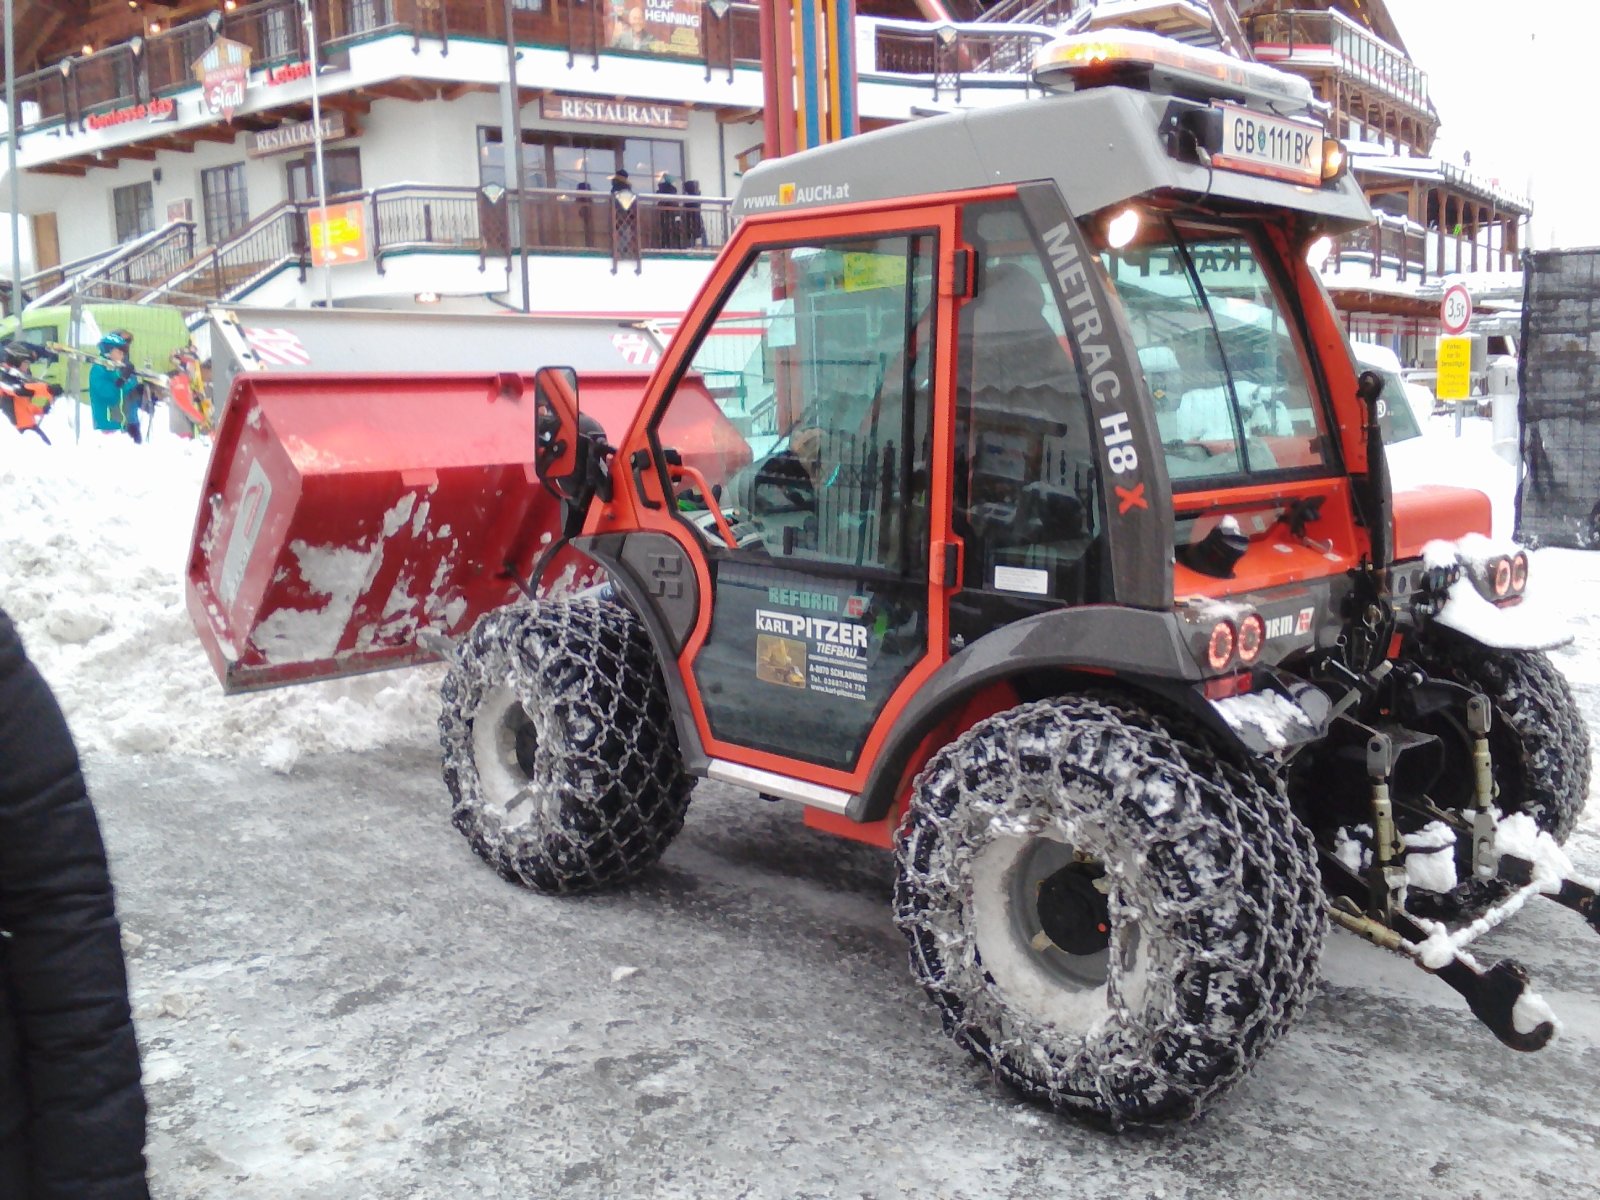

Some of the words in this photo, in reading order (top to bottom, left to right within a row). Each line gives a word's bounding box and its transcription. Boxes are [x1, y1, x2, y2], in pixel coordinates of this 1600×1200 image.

[645, 9, 699, 27] HENNING
[560, 99, 672, 126] RESTAURANT
[1234, 117, 1255, 154] GB
[1447, 298, 1465, 320] 3,5t
[1042, 221, 1121, 403] METRAC
[1100, 411, 1138, 475] H8
[768, 587, 838, 612] REFORM
[755, 609, 790, 635] KARL
[791, 615, 868, 648] PITZER
[816, 641, 858, 659] TIEFBAU
